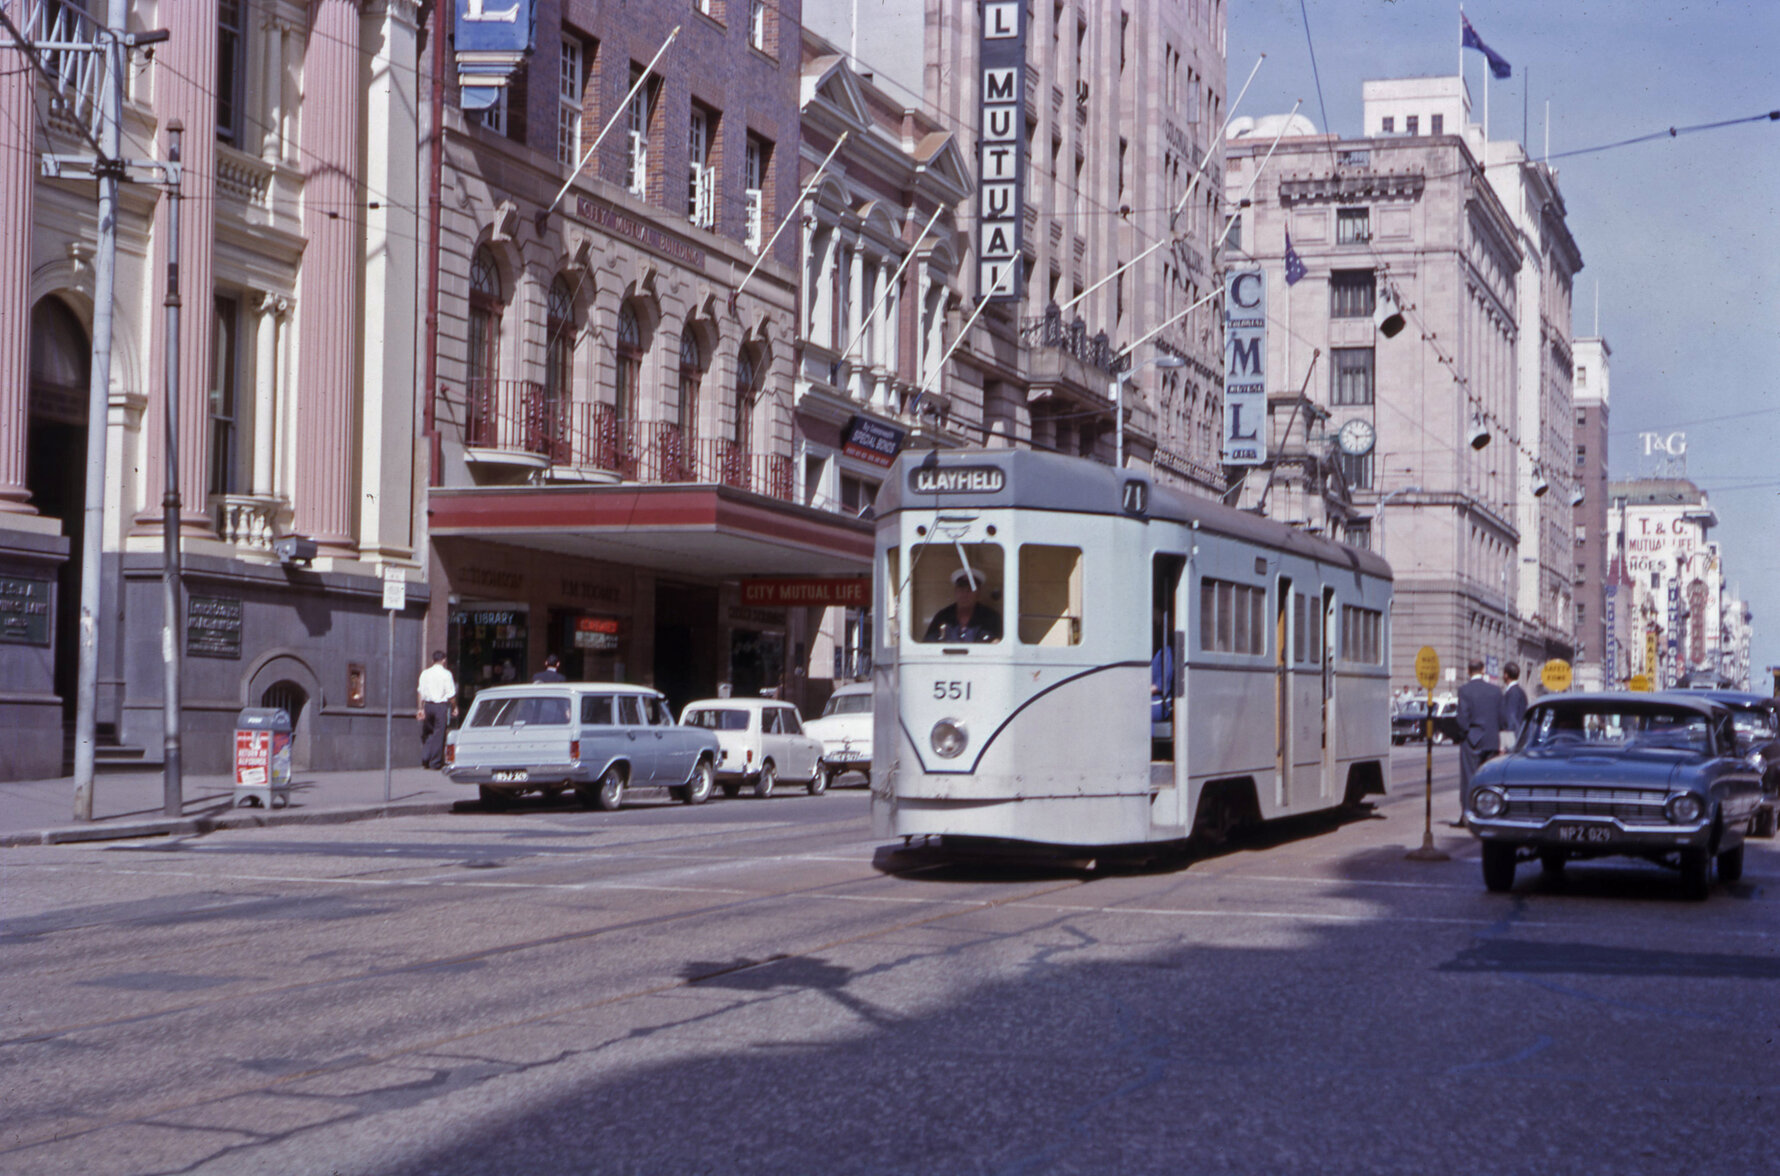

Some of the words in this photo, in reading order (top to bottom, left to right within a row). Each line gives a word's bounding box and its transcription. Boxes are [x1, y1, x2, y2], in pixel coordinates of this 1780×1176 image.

[987, 72, 1014, 291] MUTUAL
[583, 201, 606, 226] CITY
[615, 217, 651, 243] MUTUAL
[659, 236, 700, 265] BUILDING
[1639, 431, 1687, 455] T&G
[917, 471, 1003, 491] CLAYFIELD
[746, 584, 774, 599] CITY
[780, 584, 830, 600] MUTUAL
[835, 585, 861, 599] LIFE
[474, 611, 515, 625] LIBRARY
[933, 681, 971, 701] 551
